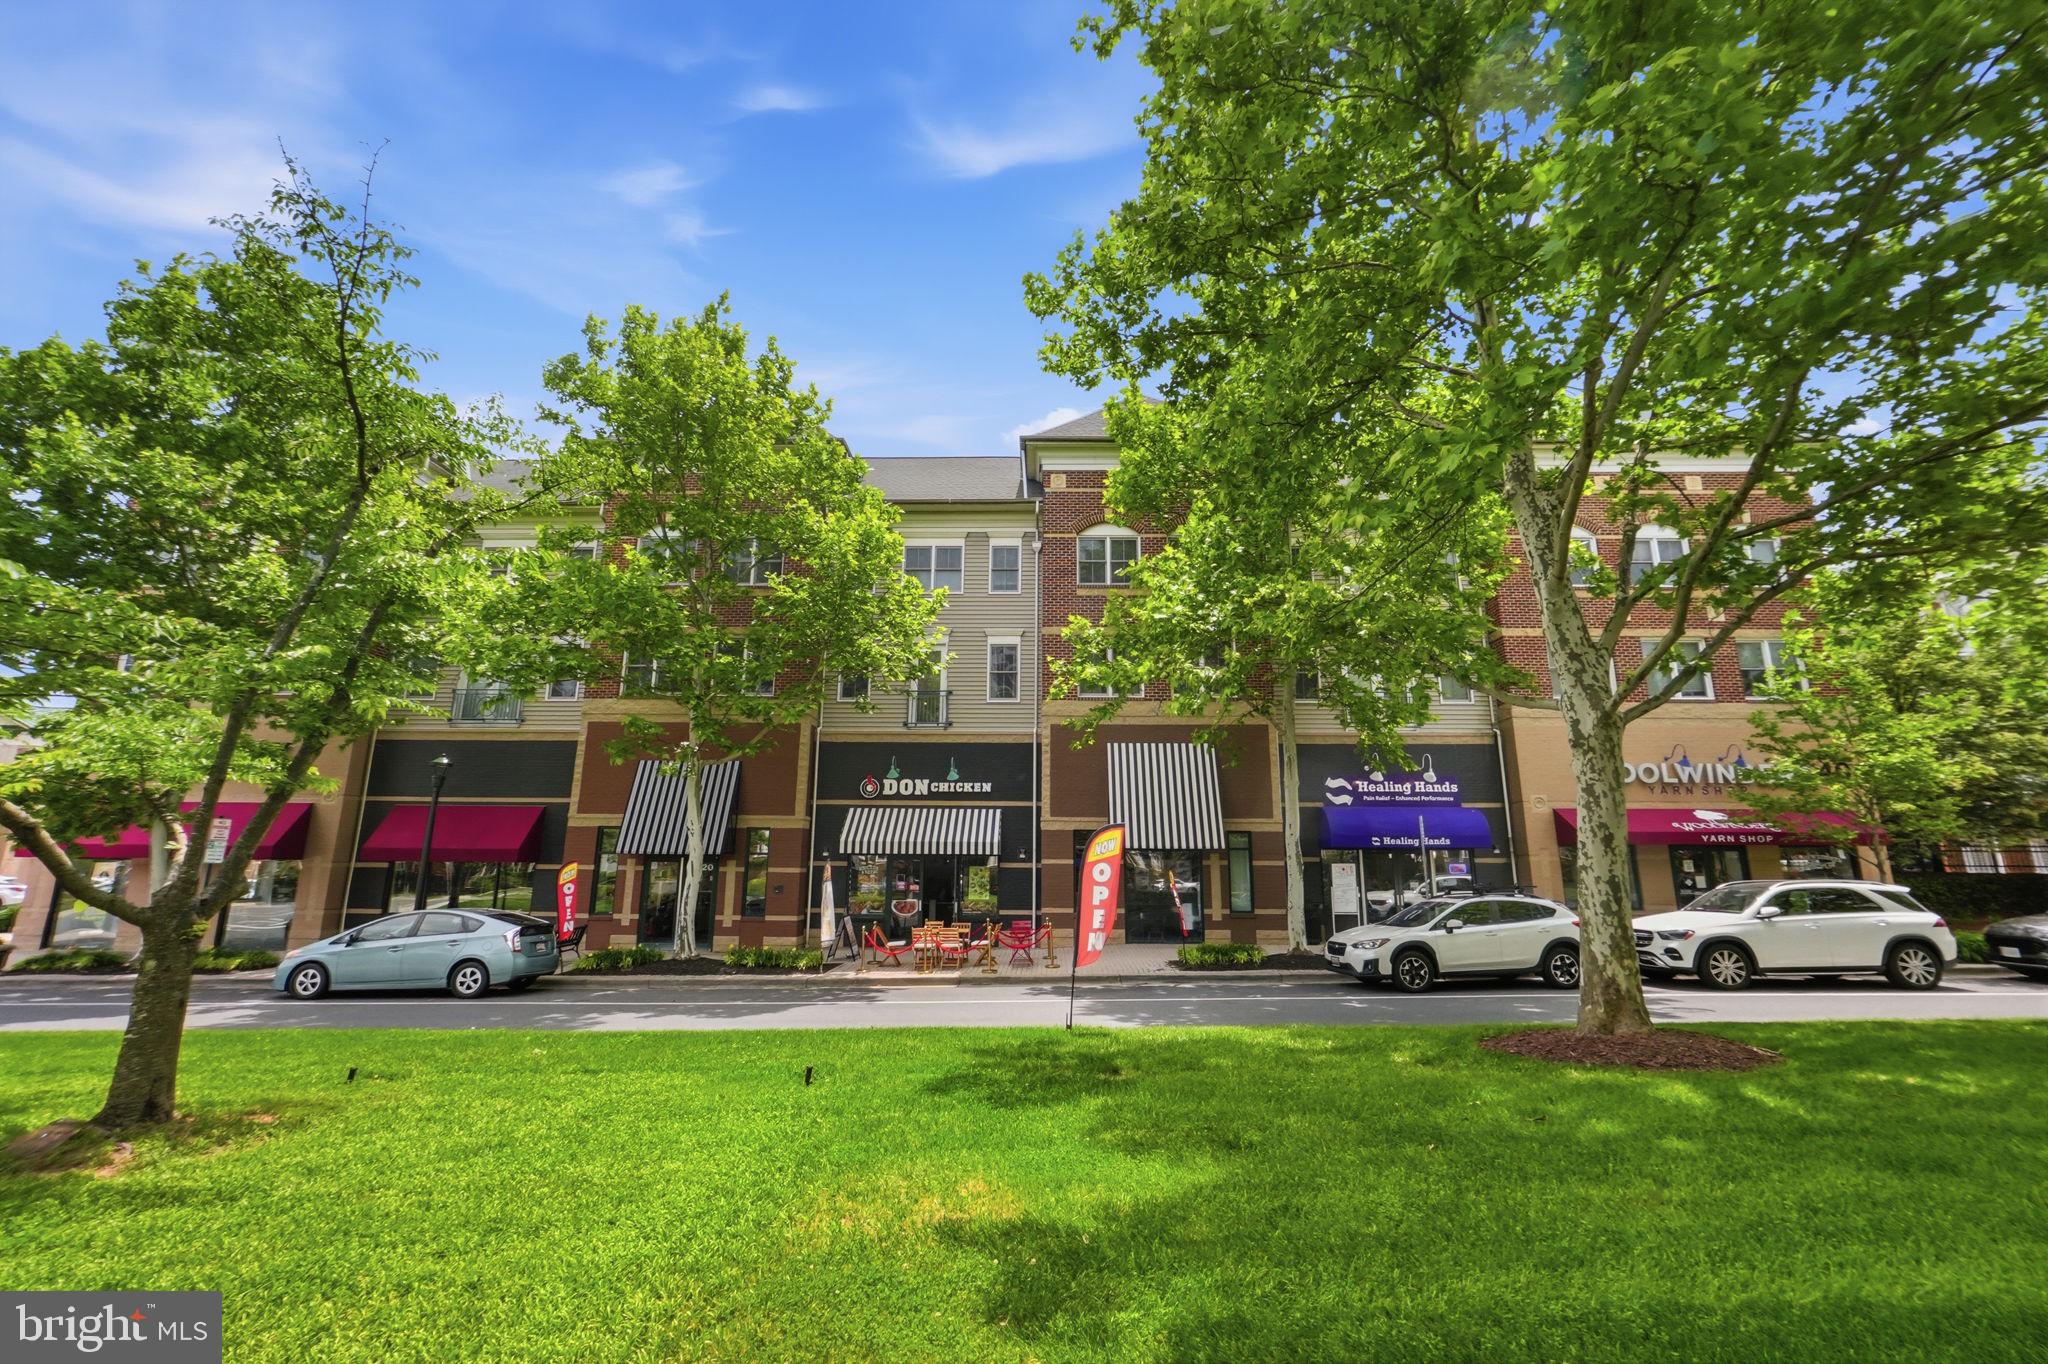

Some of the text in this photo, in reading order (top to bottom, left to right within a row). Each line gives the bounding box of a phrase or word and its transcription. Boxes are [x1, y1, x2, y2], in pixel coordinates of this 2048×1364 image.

[882, 778, 992, 796] DON CHICKEN
[1358, 781, 1458, 795] Healing Hands
[1648, 785, 1694, 795] YARN
[1383, 837, 1419, 846] Healing
[1739, 835, 1774, 843] SHOP
[1094, 839, 1116, 855] NOW
[562, 882, 575, 932] OPEN
[1087, 862, 1112, 952] OPEN
